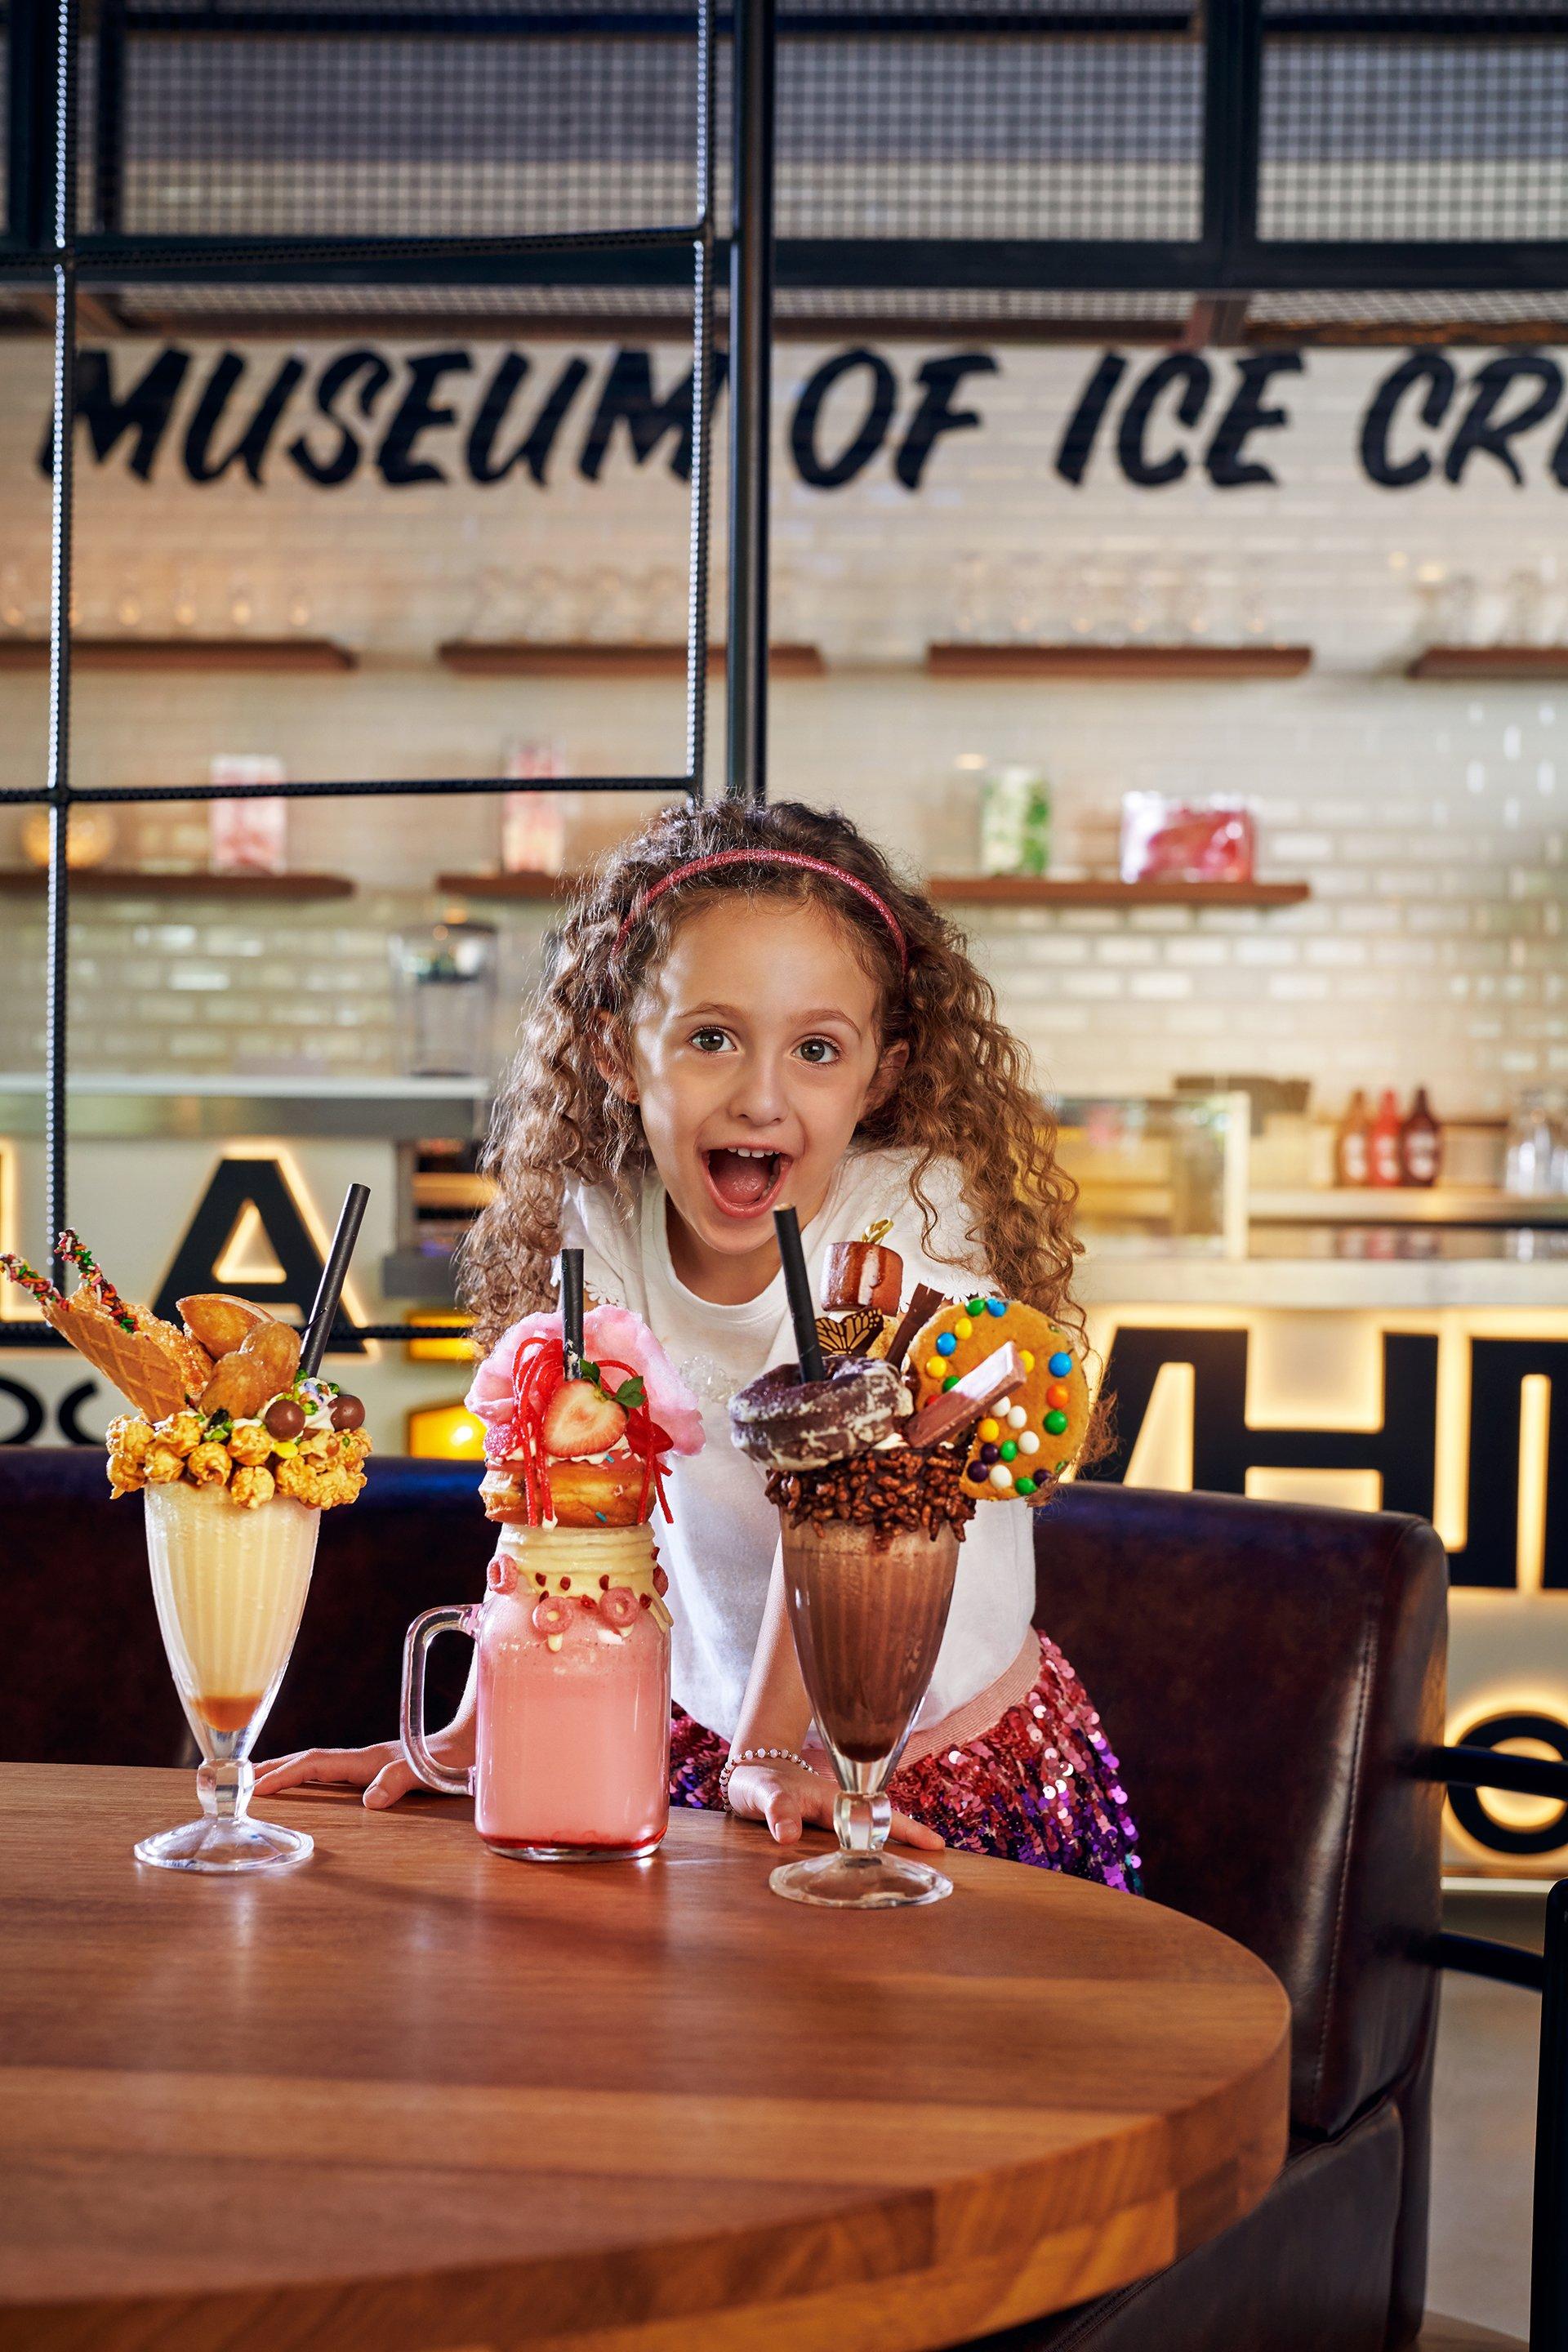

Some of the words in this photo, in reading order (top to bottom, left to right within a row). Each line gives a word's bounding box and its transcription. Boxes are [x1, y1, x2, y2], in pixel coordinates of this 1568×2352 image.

[38, 347, 730, 487] MUSEUM
[789, 345, 1000, 492] OF
[1053, 349, 1305, 489] ICE
[1356, 347, 1568, 489] CR
